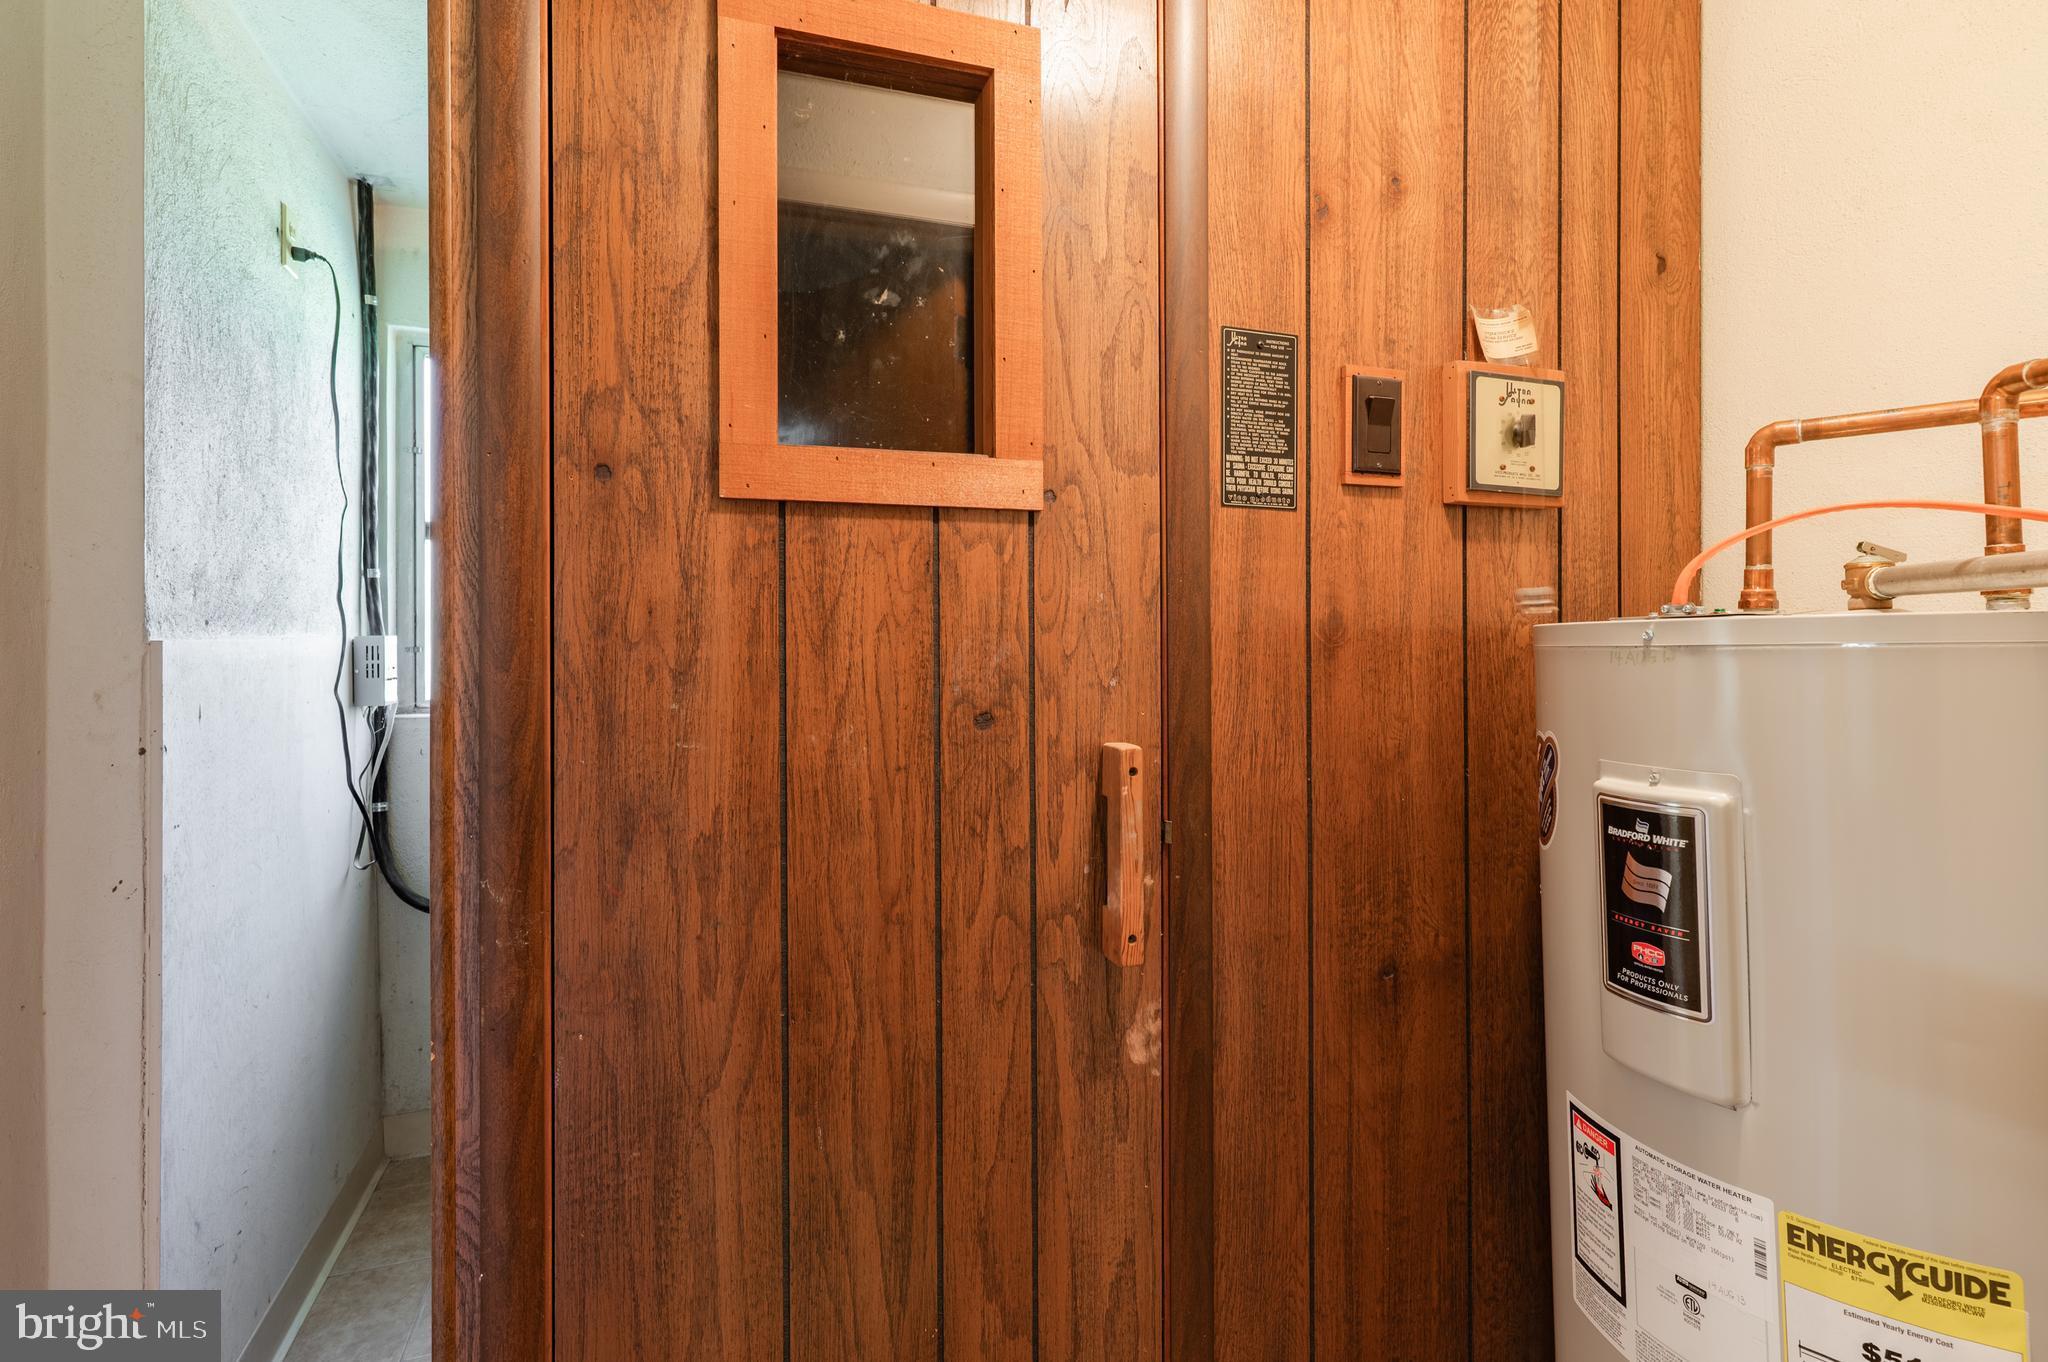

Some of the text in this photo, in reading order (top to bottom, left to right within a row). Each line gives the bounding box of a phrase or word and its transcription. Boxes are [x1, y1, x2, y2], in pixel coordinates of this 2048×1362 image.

[1608, 826, 1651, 842] BRADFORD
[1615, 914, 1684, 937] ENERGY SAVER
[1633, 944, 1664, 959] PHCC
[1617, 972, 1689, 1002] FOR PROFESSIONALS
[1622, 968, 1680, 990] PRODUCTS ONLY
[1582, 1122, 1608, 1148] DANGER
[1634, 1144, 1752, 1204] AUTOMATIC STORAGE WATER HEATER
[1786, 1222, 2012, 1308] ENERGYGUIDE
[1832, 1262, 1862, 1277] ELECTRIC
[1923, 1293, 1962, 1306] BRADFORD
[1844, 1309, 1954, 1349] Estimated Yearly Energy Cost
[1862, 1342, 1921, 1362] $5
